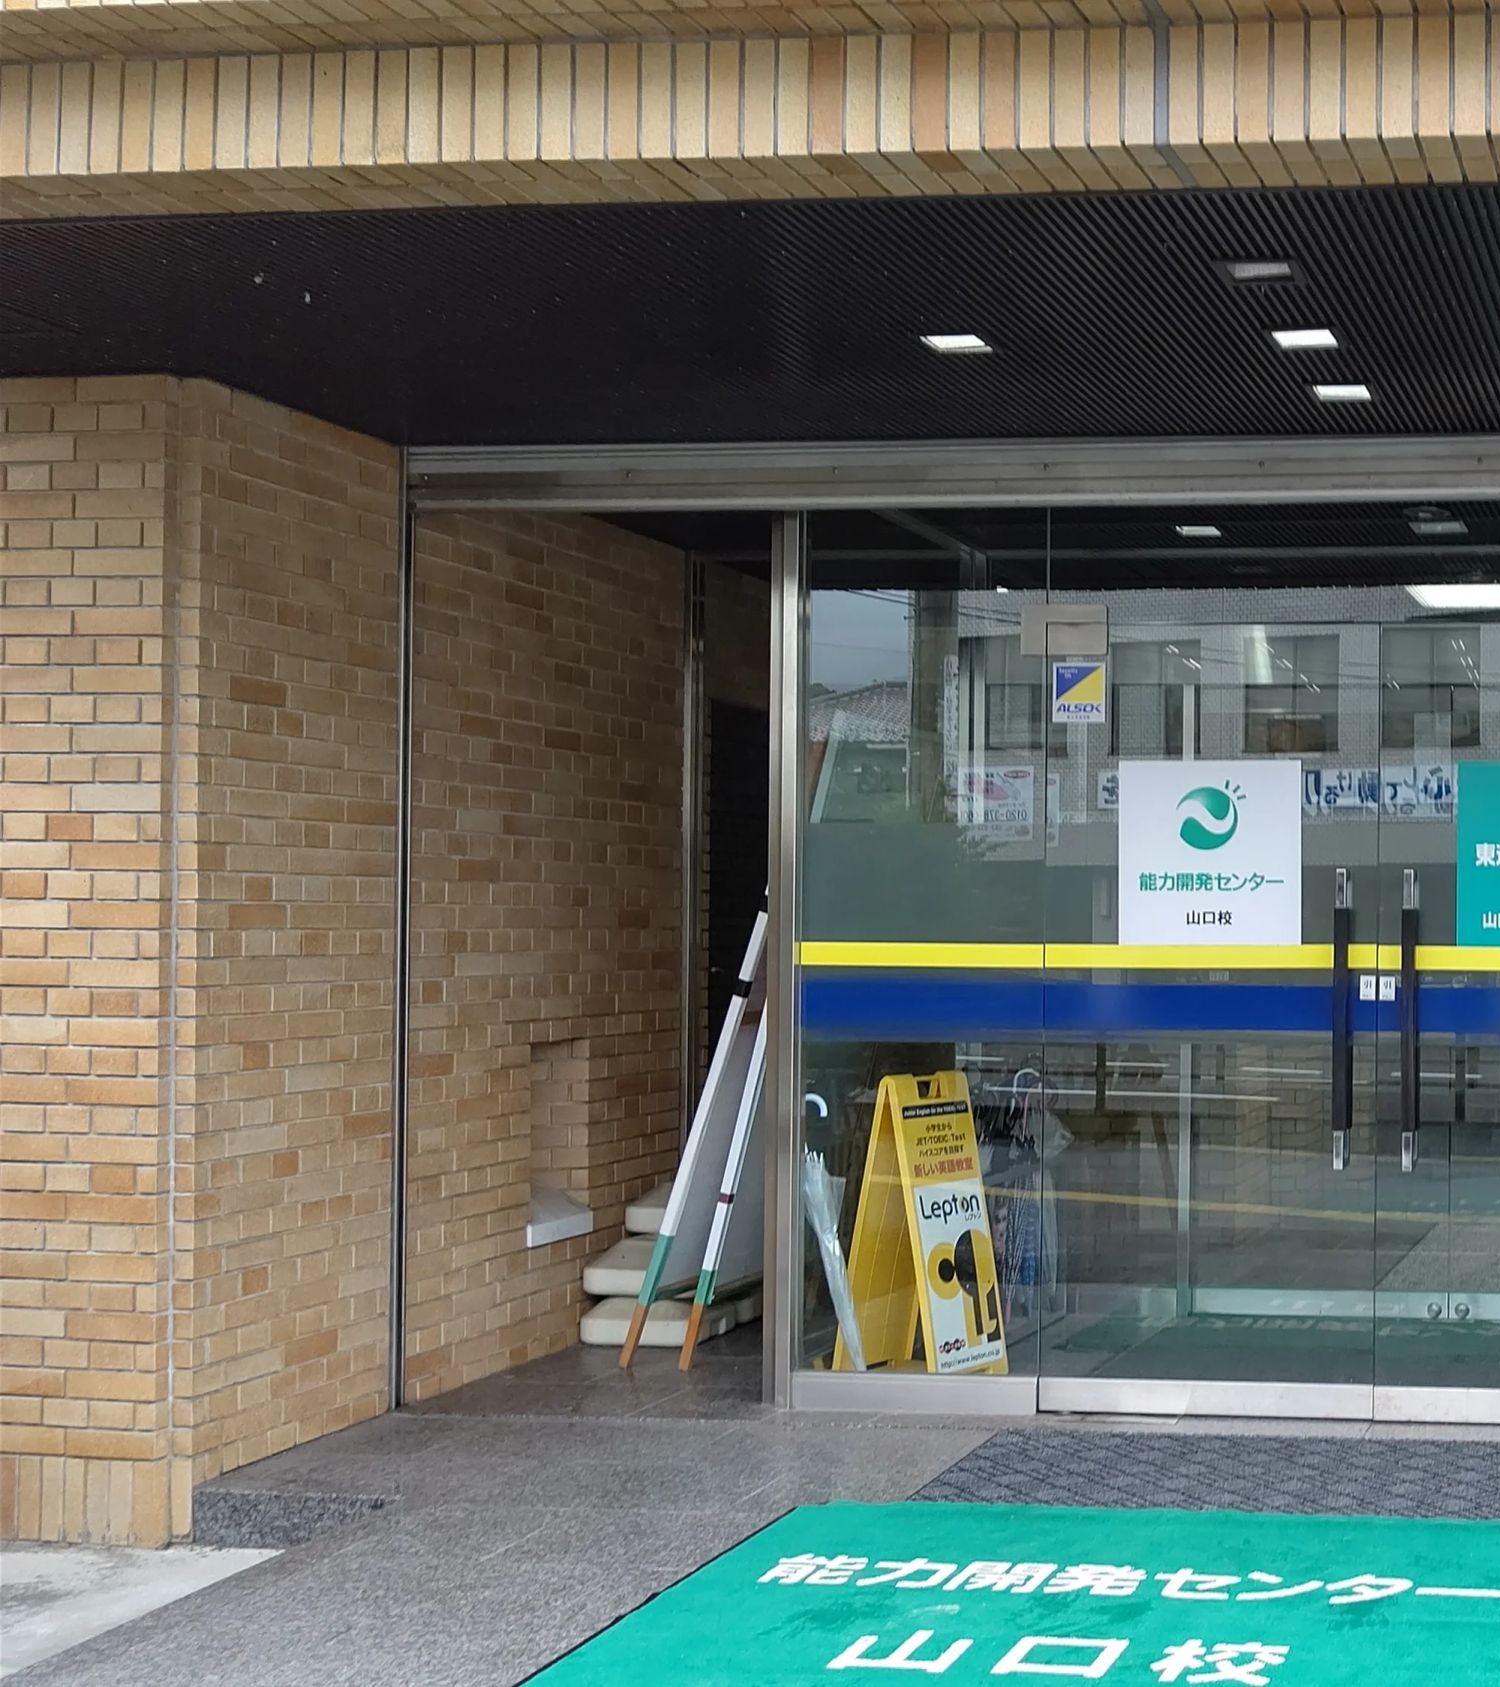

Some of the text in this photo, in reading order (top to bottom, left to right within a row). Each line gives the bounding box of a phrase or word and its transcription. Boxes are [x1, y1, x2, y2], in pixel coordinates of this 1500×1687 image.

[1056, 703, 1102, 713] ALSOK
[1138, 871, 1285, 892] 能力開発センター
[1186, 909, 1233, 925] 山口校
[914, 1157, 973, 1178] 新しい英語教室
[919, 1193, 980, 1224] Lepton
[825, 1629, 1290, 1686] 山口校
